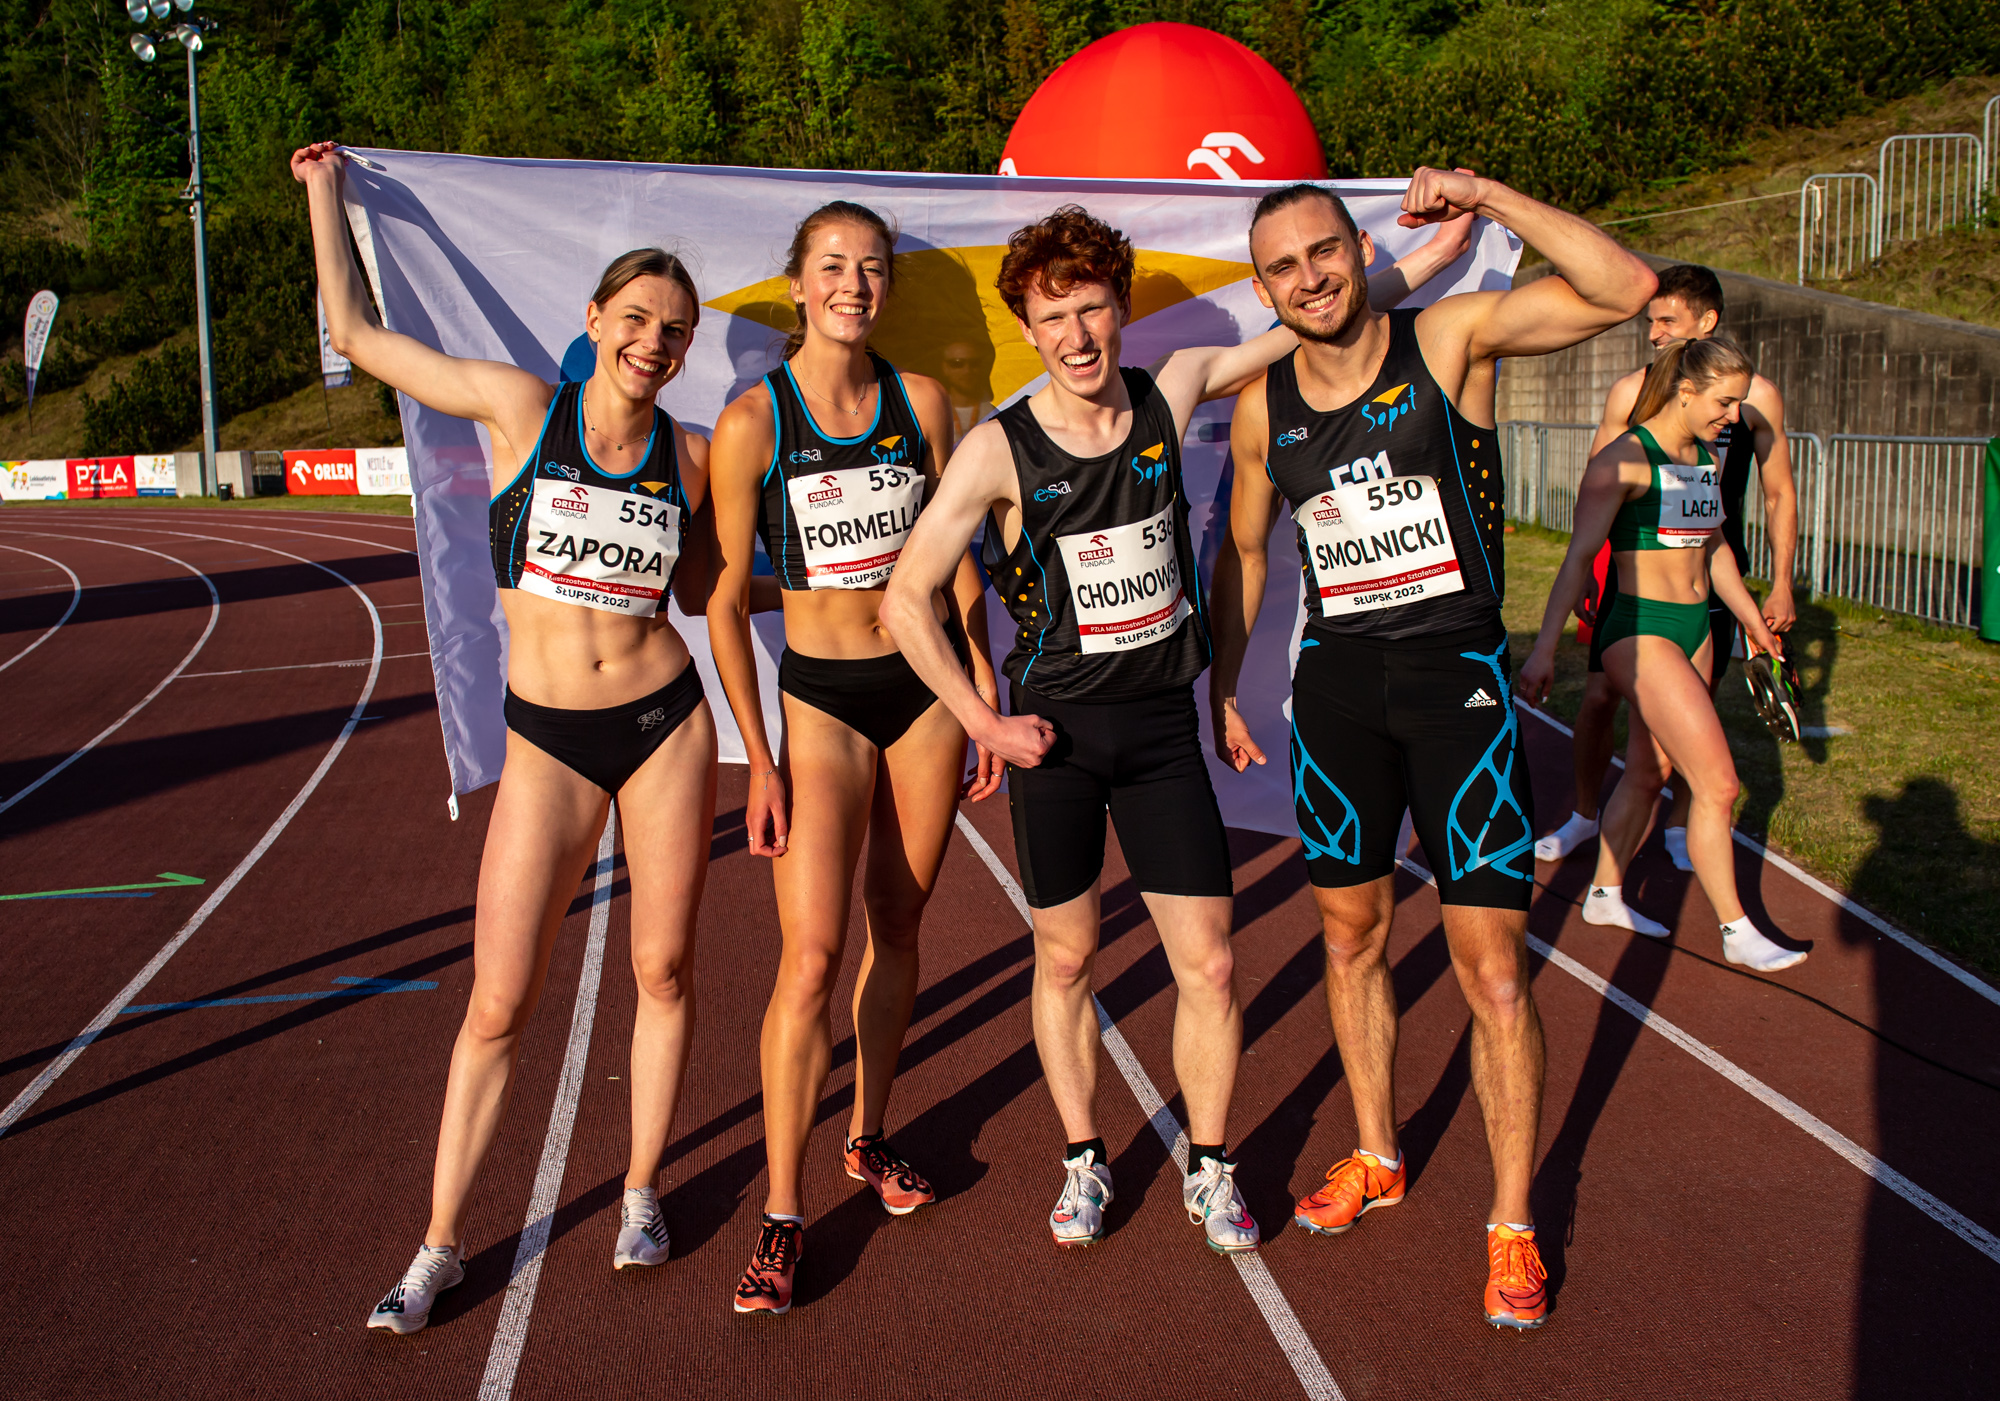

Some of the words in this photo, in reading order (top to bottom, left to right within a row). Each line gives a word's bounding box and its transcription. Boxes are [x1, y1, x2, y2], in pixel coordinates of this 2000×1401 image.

[1361, 384, 1417, 433] Sopot
[871, 436, 909, 465] Sopot
[75, 464, 128, 485] PZLA
[314, 463, 354, 481] ORLEN
[809, 489, 841, 502] ORLEN
[809, 498, 844, 510] FUNDACJA
[1367, 479, 1423, 511] 550
[551, 508, 587, 520] FUNDACJA
[553, 499, 588, 512] ORLEN
[618, 499, 669, 532] 554
[1314, 509, 1340, 520] ORLEN
[1682, 499, 1718, 518] LACH
[803, 501, 920, 551] FORMELLA
[1142, 511, 1173, 550] 536
[1317, 518, 1344, 528] FUNDACJA
[536, 530, 663, 577] ZAPORA
[1316, 517, 1446, 571] SMOLNICKI
[834, 560, 873, 572] Mistrzostwa
[873, 555, 891, 565] Polski
[1080, 548, 1112, 561] ORLEN
[1080, 557, 1115, 568] FUNDACJA
[548, 574, 591, 587] Mistrzostwa
[620, 586, 653, 597] Sztafetach
[842, 570, 884, 585] SŁUPSK
[1330, 587, 1344, 595] PZLA
[1344, 582, 1379, 593] Mistrzostwa
[1379, 578, 1399, 587] Polski
[1406, 565, 1446, 581] Sztafetach
[555, 585, 600, 603] SŁUPSK
[602, 596, 630, 609] 2023
[1353, 591, 1393, 606] SŁUPSK
[1394, 584, 1424, 599] 2023
[1105, 620, 1146, 632] Mistrzostwa
[1146, 611, 1164, 623] Polski
[1114, 626, 1158, 645] SŁUPSK
[1464, 699, 1497, 708] adidas
